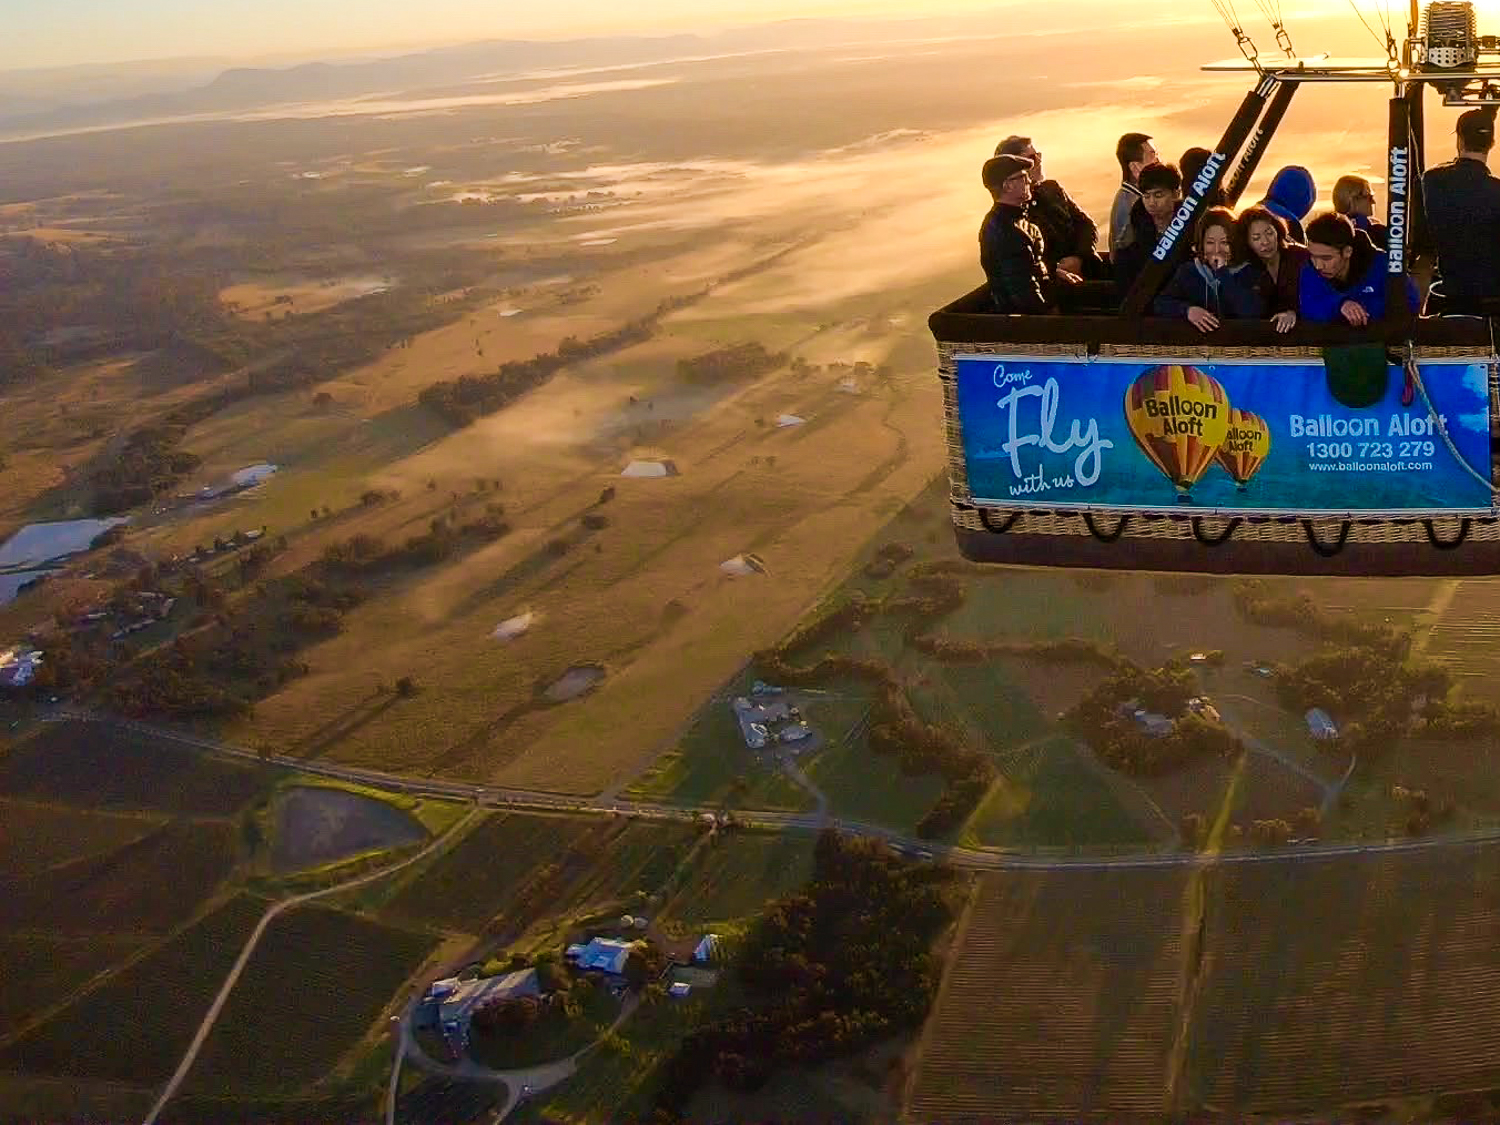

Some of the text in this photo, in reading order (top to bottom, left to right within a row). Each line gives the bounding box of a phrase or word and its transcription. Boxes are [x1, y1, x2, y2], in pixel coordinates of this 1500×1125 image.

[1153, 152, 1226, 260] Balloon Aloft
[1388, 146, 1408, 272] Balloon Aloft
[993, 364, 1033, 387] Come
[1145, 396, 1217, 419] Balloon
[997, 377, 1113, 486] Fly
[1163, 416, 1203, 436] Aloft
[1226, 428, 1261, 441] alloon
[1289, 414, 1379, 437] Balloon
[1306, 441, 1435, 458] 1300 723 279
[1308, 461, 1433, 472] www.balloonaloft.com
[1009, 464, 1075, 495] with us
